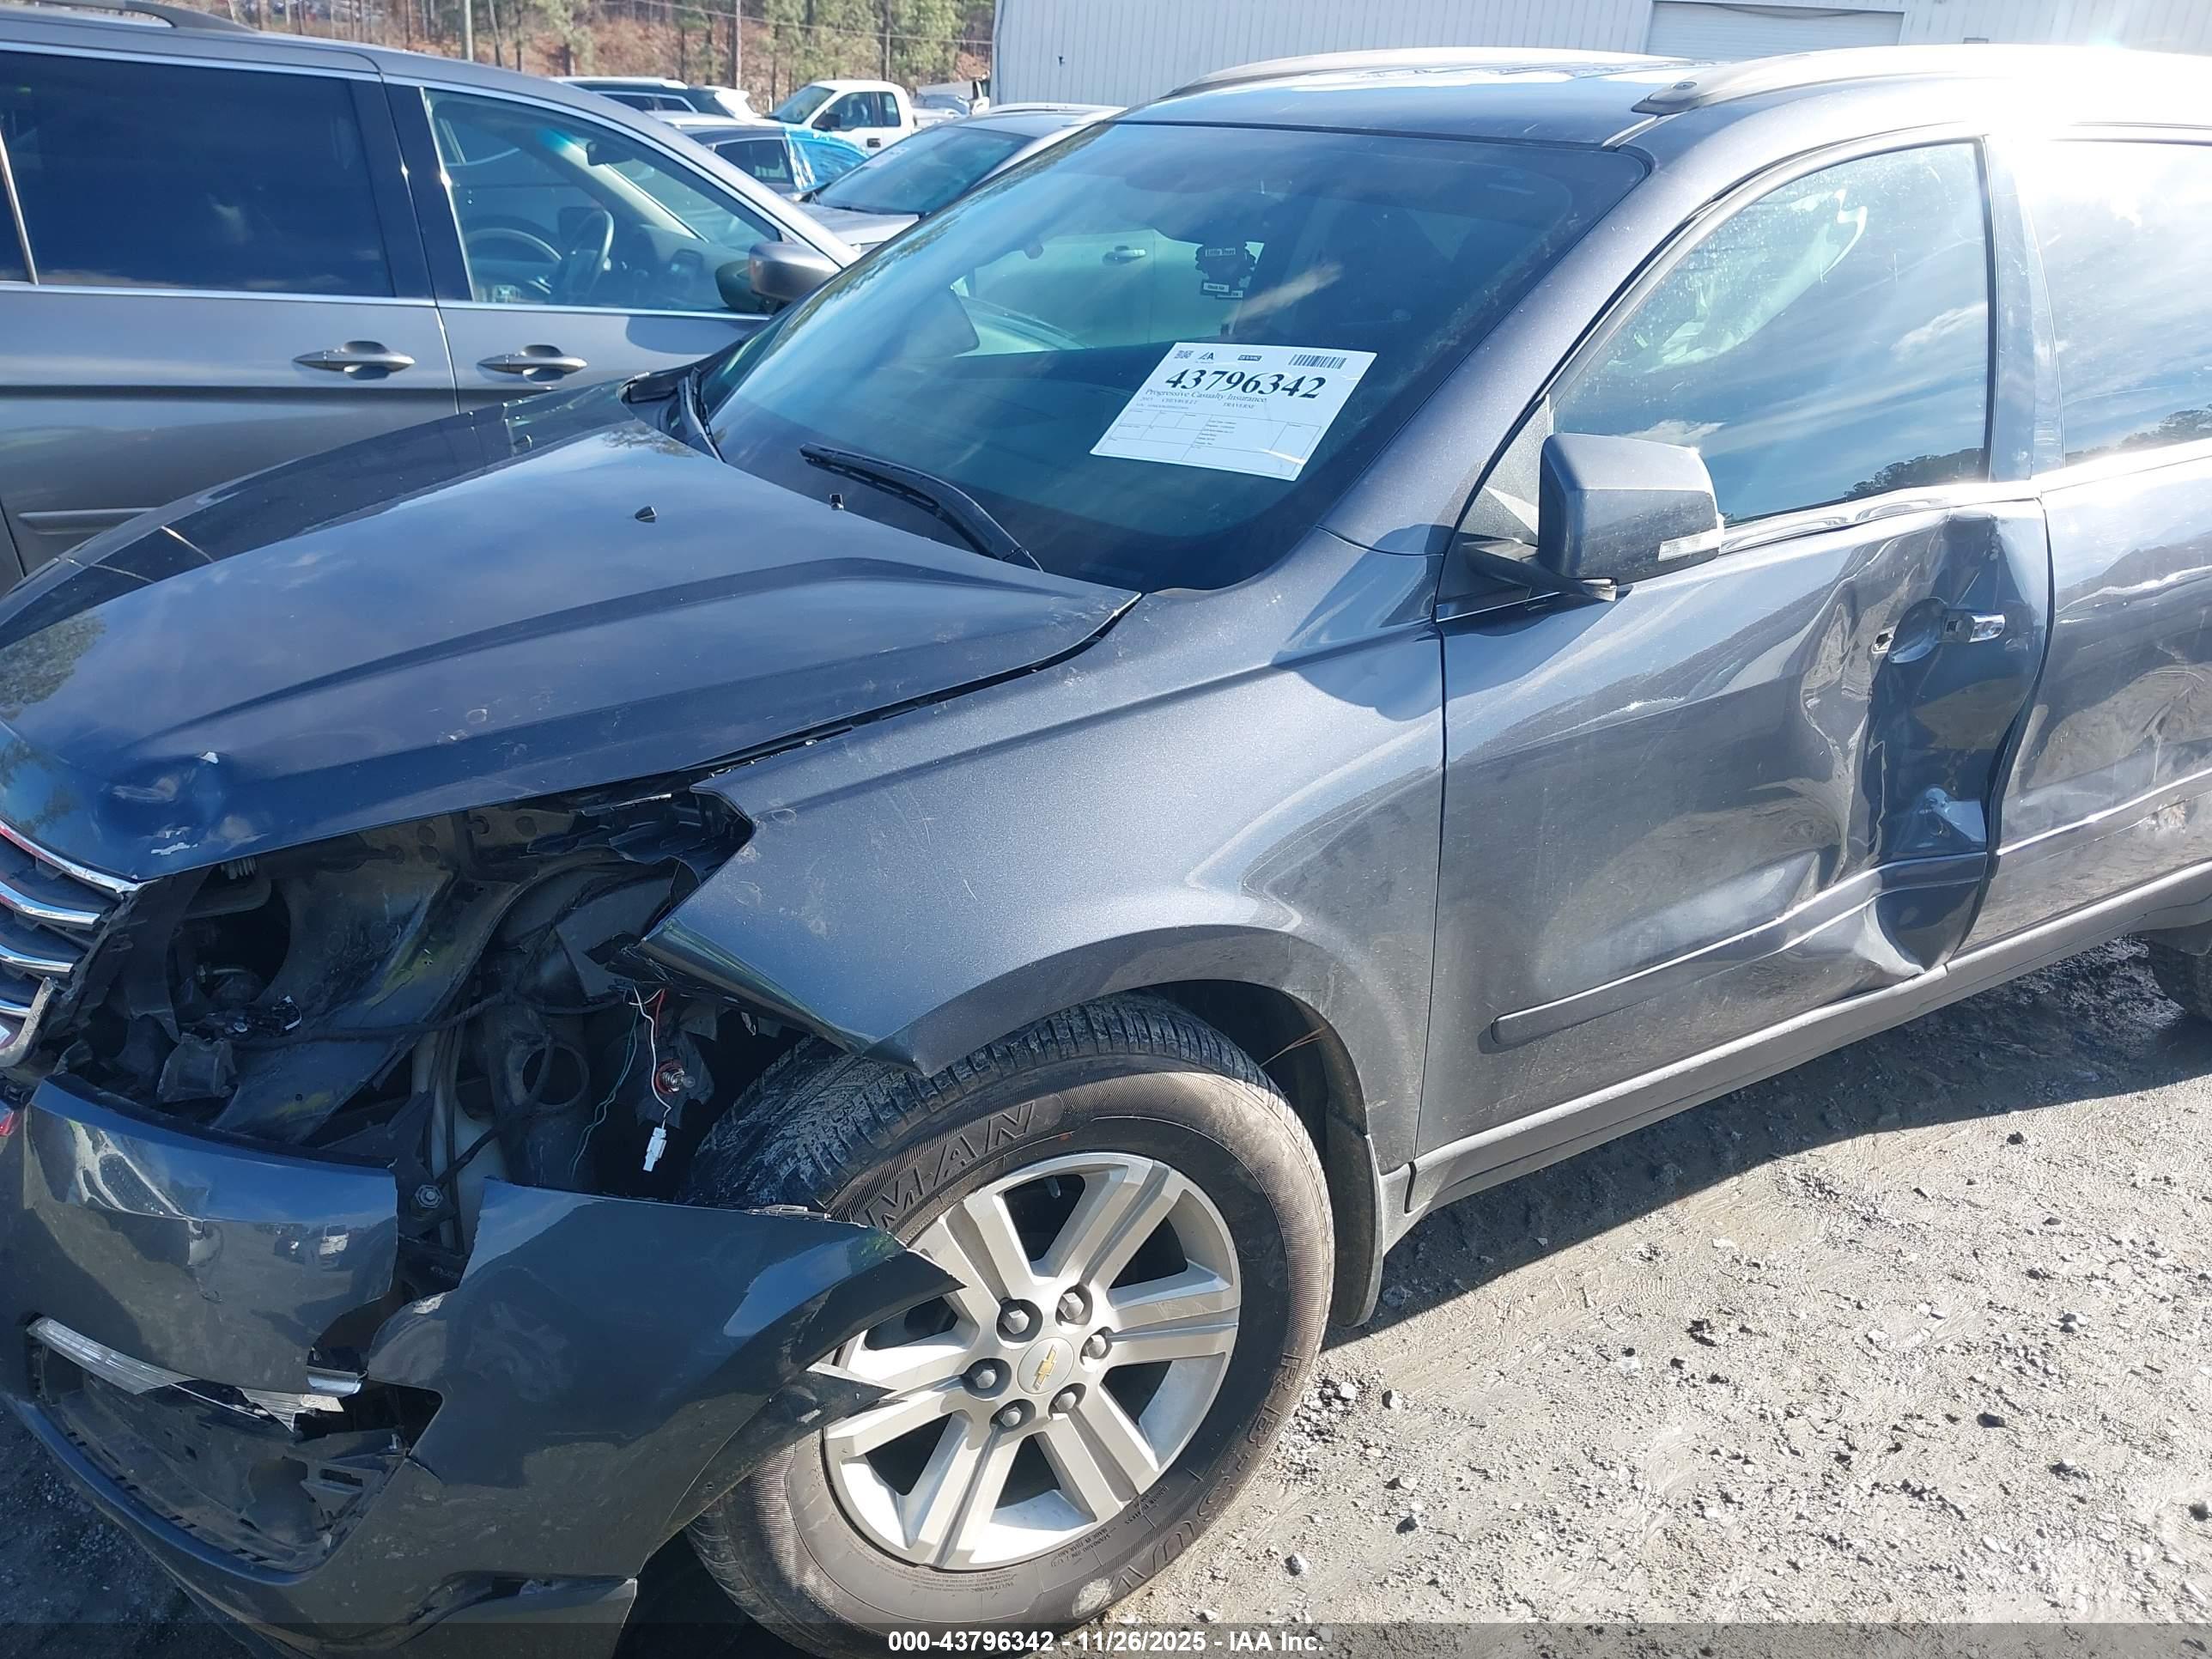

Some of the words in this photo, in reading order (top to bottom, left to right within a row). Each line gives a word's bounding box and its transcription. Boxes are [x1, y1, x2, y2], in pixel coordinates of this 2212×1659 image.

[1165, 368, 1327, 399] 43796342
[1145, 388, 1191, 399] Progressive
[1191, 391, 1224, 401] Casualty
[1226, 393, 1267, 403] Insurance
